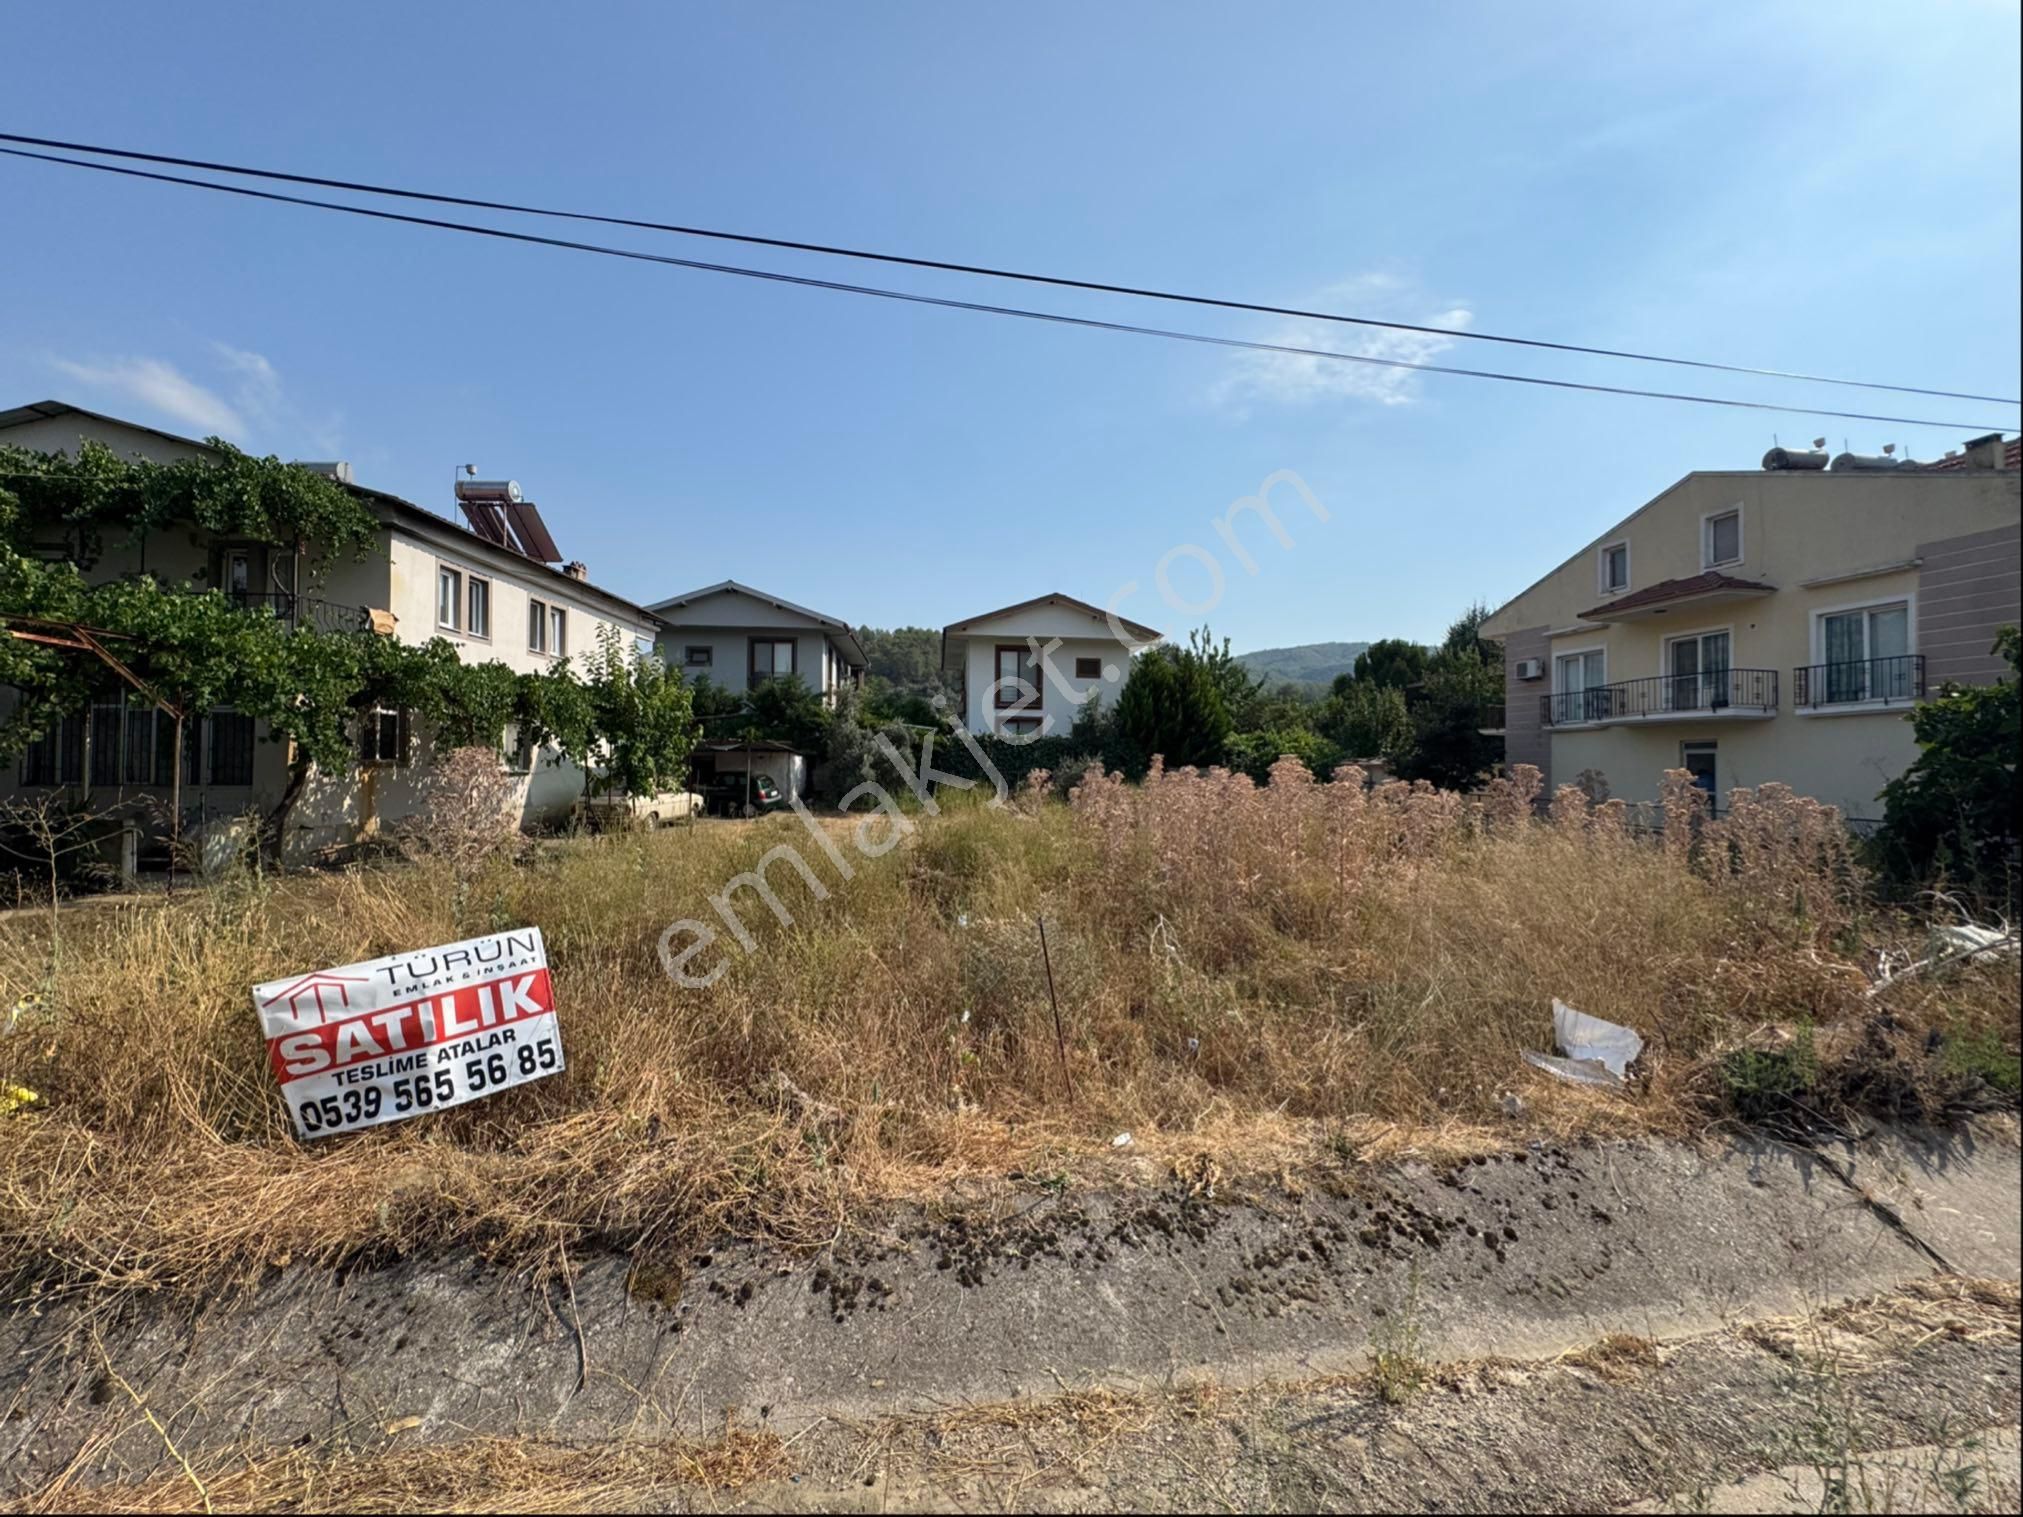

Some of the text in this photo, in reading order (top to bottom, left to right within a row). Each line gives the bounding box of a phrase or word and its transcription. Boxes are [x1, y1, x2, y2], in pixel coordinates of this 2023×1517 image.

[377, 933, 535, 985] TÜRÜN
[393, 975, 455, 997] EMLAK
[280, 975, 543, 1075] SATILIK
[300, 1038, 556, 1132] 0539 565 56 85
[332, 1028, 517, 1087] TESLİME ATALAR
